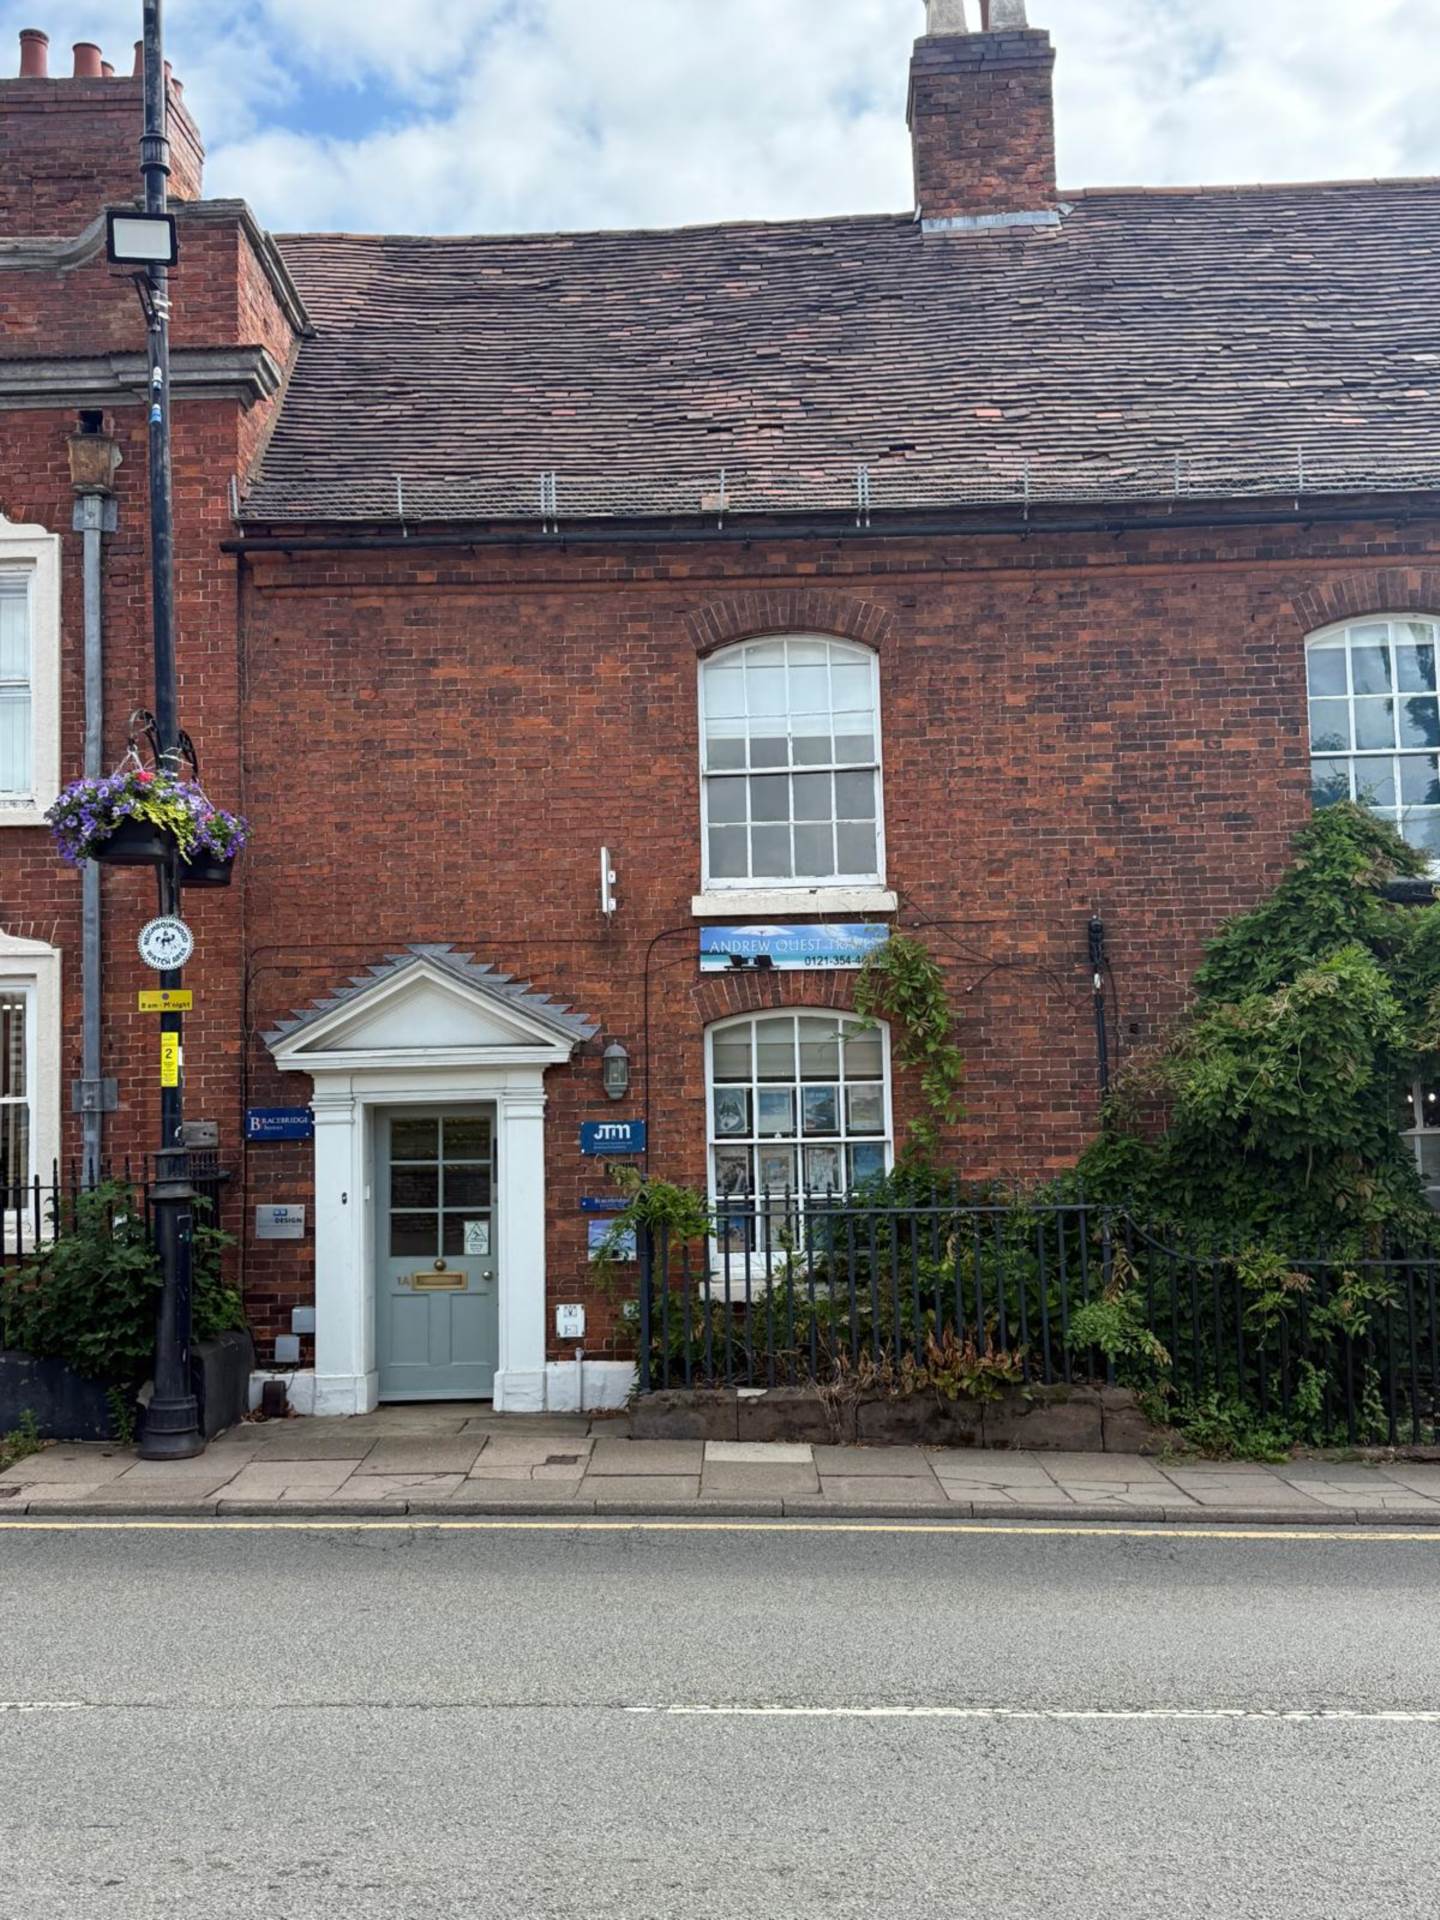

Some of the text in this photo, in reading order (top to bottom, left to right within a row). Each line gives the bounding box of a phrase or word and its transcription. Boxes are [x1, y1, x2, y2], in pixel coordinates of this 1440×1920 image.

[709, 939, 771, 953] ANDREW
[776, 938, 823, 951] QUEST
[146, 947, 187, 965] WATCH AREA
[165, 1047, 172, 1059] 2
[250, 1116, 308, 1131] BRACEBRIDGE
[274, 1216, 302, 1224] DESIGN
